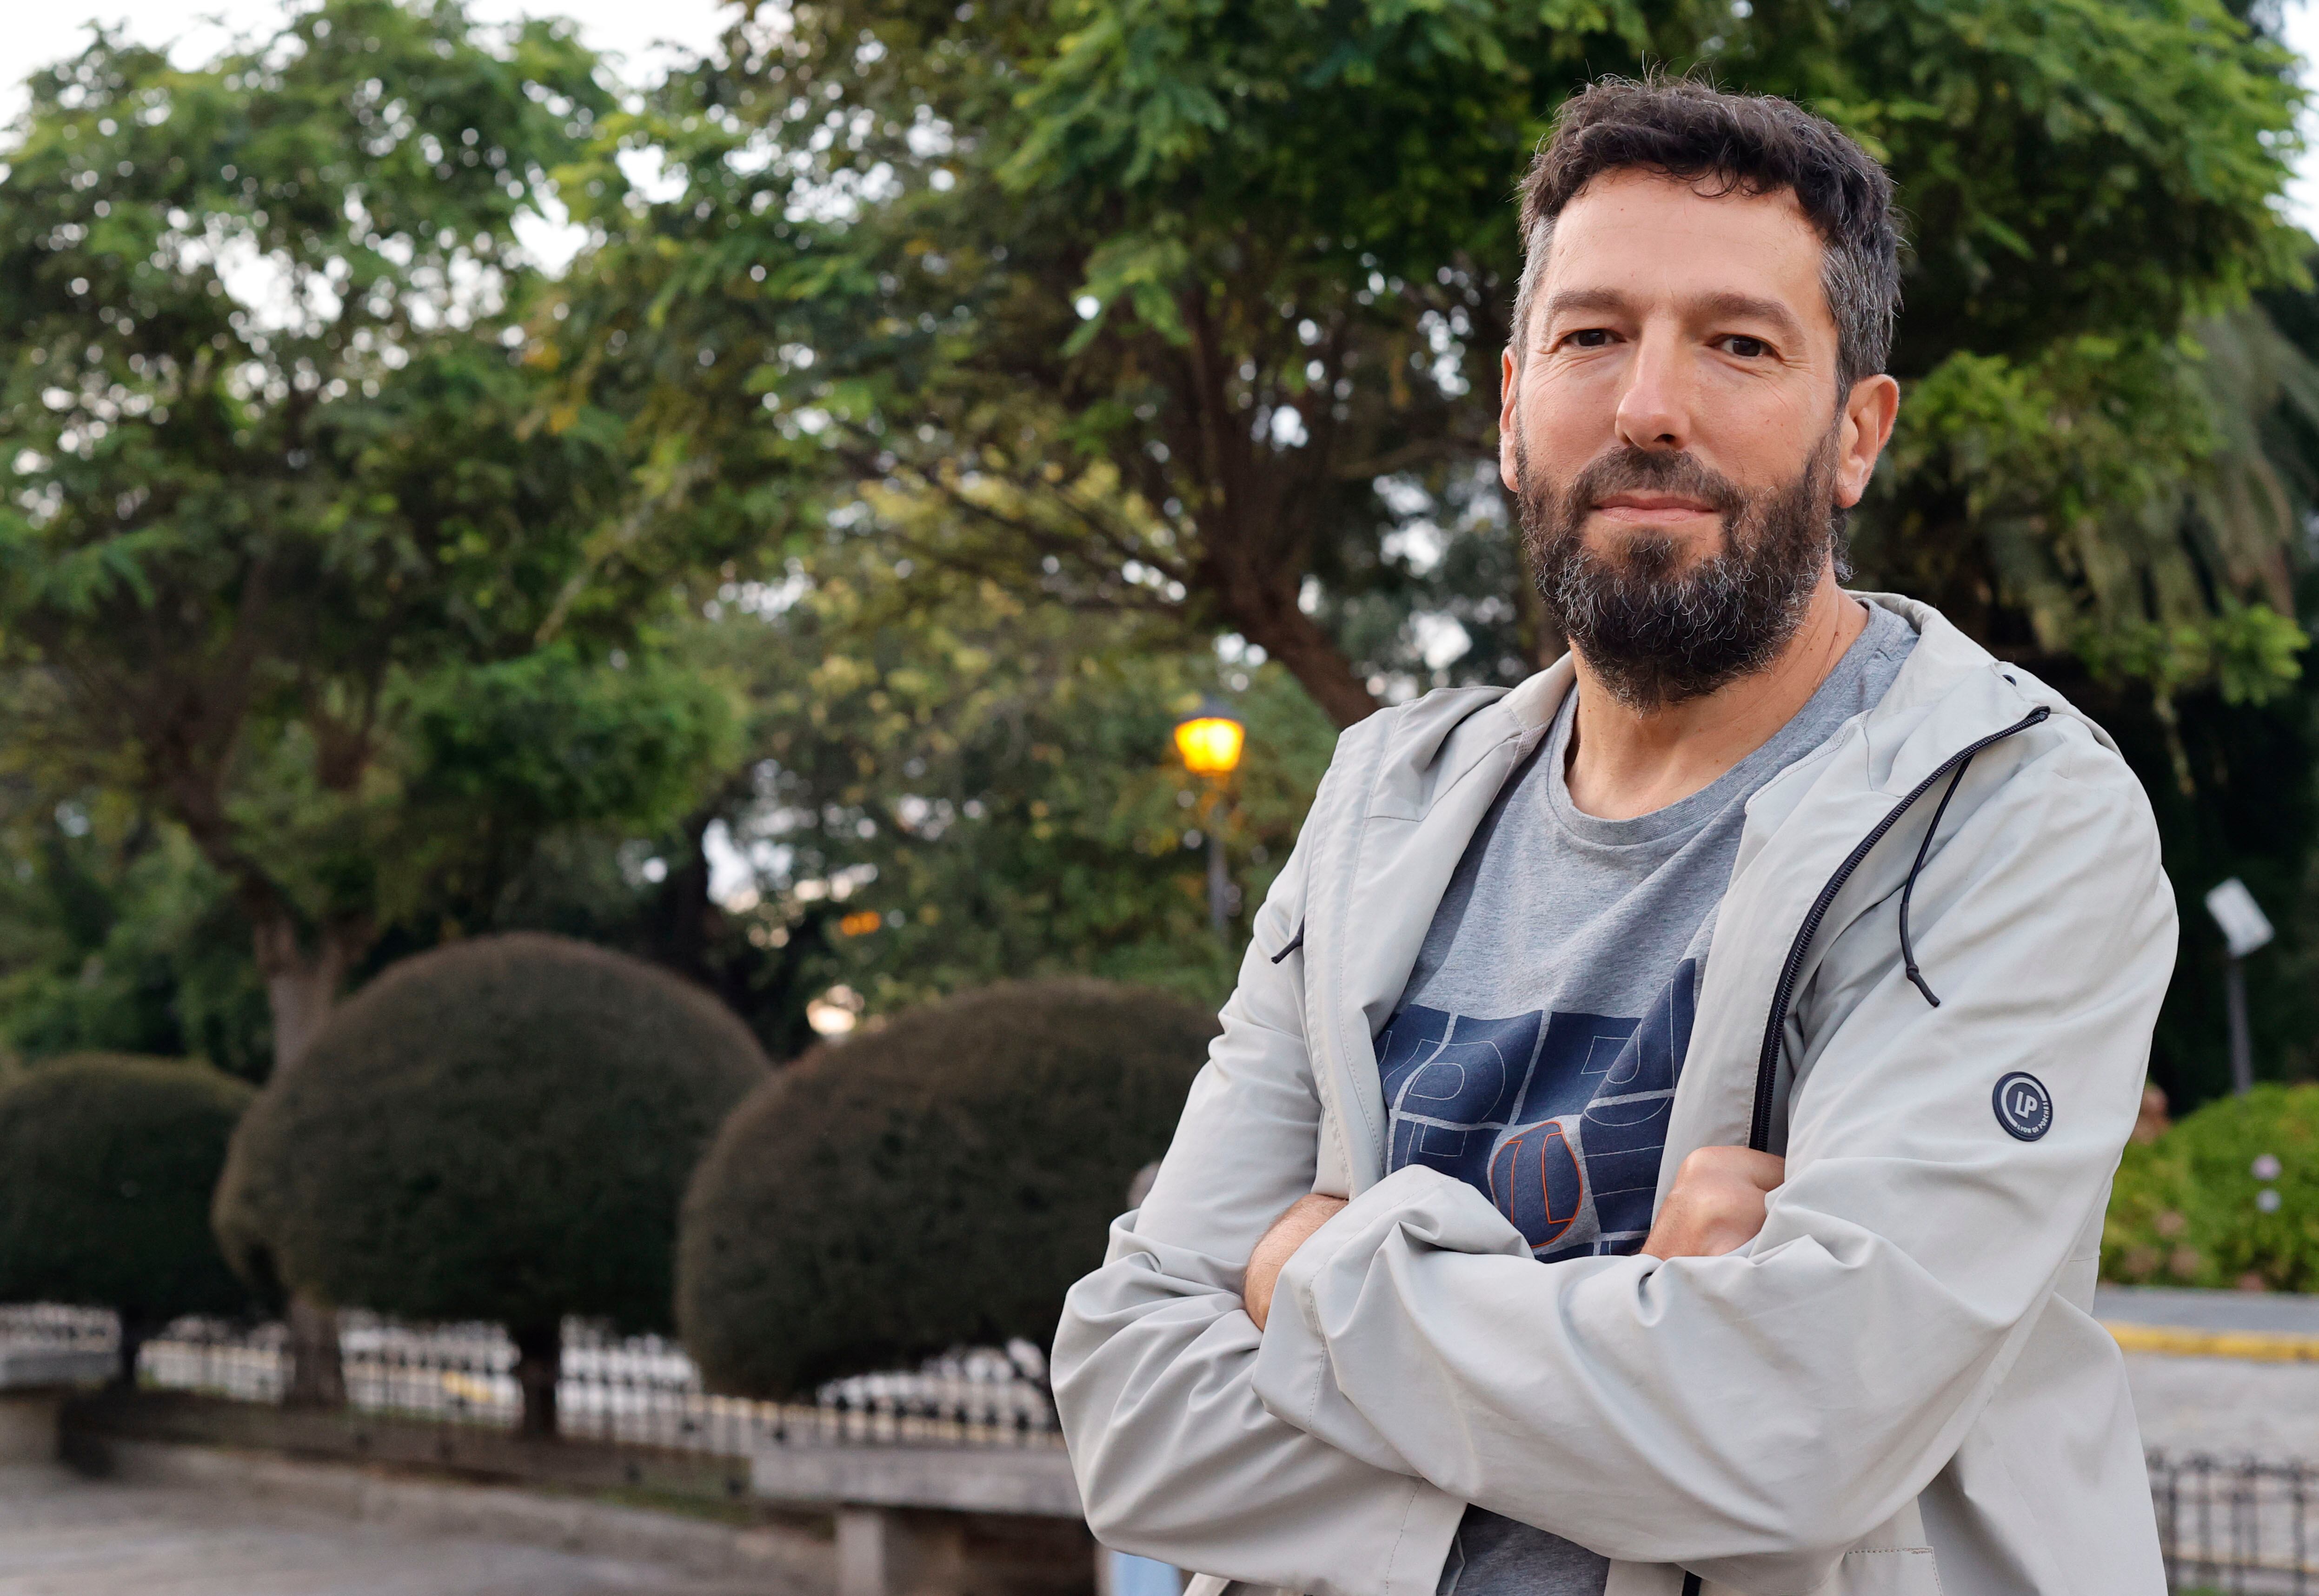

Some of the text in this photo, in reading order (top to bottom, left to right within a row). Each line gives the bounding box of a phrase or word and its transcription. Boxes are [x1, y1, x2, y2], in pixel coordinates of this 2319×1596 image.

[2014, 1091, 2038, 1118] LP
[2017, 1125, 2031, 1133] LION
[2038, 1102, 2049, 1129] PORCHES
